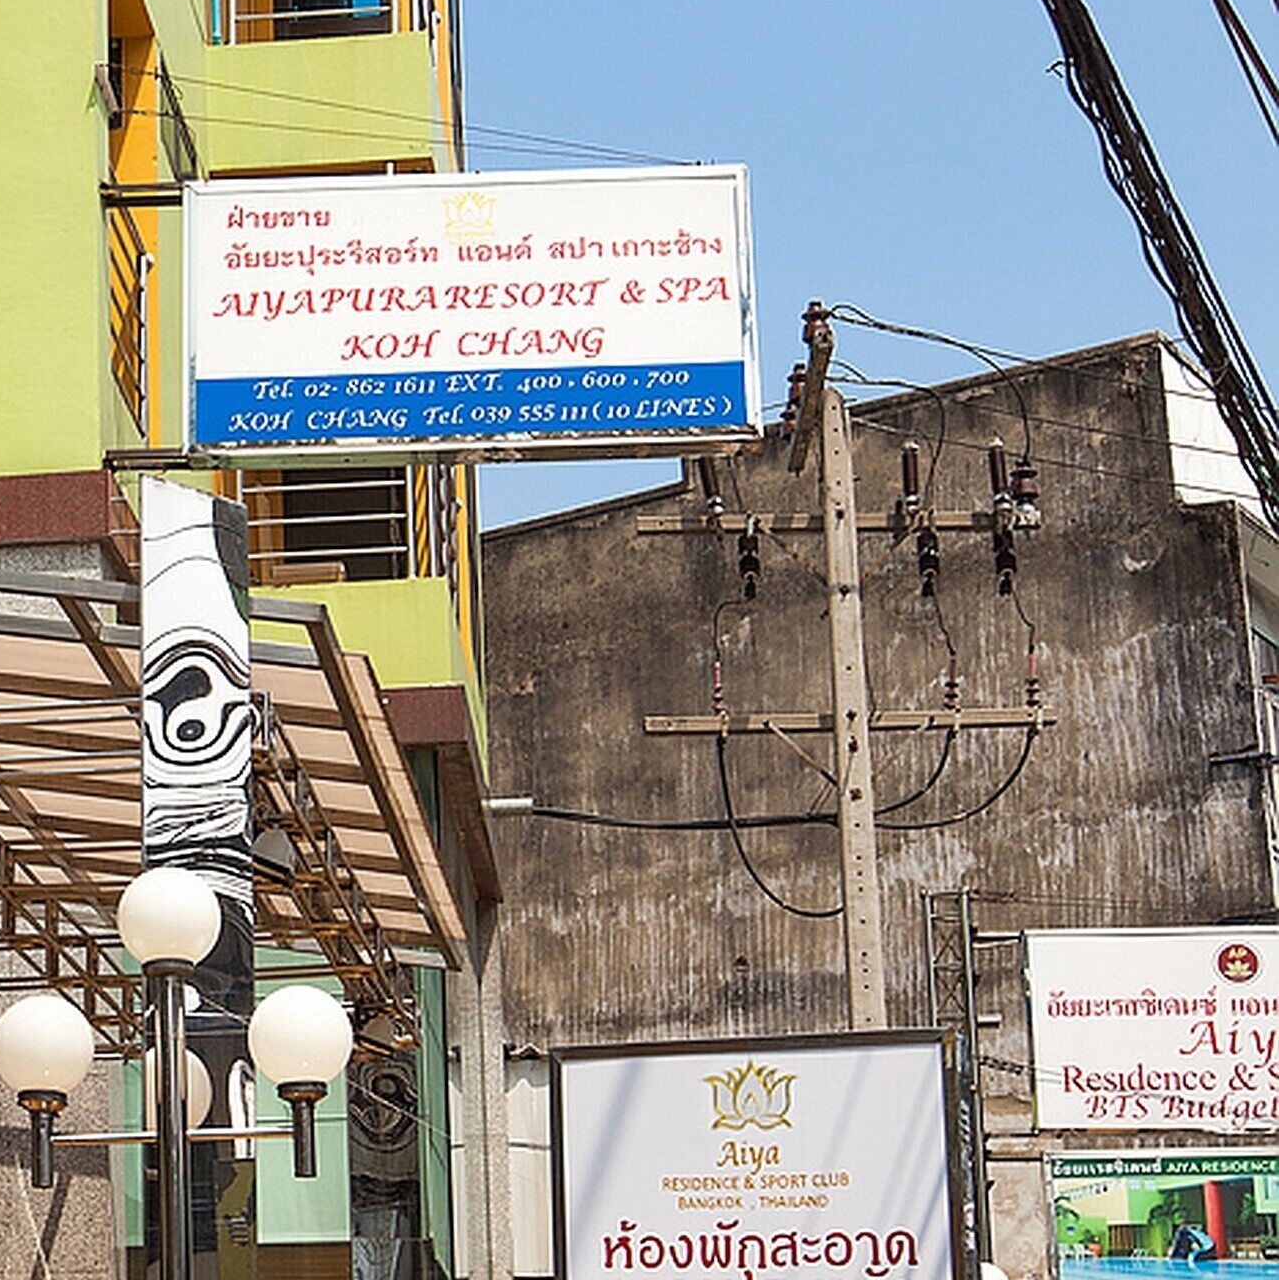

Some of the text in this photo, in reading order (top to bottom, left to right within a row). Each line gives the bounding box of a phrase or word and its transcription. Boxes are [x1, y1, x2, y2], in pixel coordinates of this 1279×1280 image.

[227, 205, 331, 229] ฝ่ายขาย
[459, 234, 532, 262] แอนด์
[548, 236, 603, 260] สปา
[612, 229, 722, 258] เกาะช้าง
[620, 279, 646, 305] &
[656, 276, 732, 304] SPA
[340, 326, 605, 361] KOH CHANG
[253, 379, 295, 400] Tel.
[228, 409, 295, 432] KOH
[307, 407, 409, 431] CHANG
[471, 406, 513, 424] 039
[1179, 1020, 1279, 1069] Aiy
[1062, 1062, 1218, 1093] Residence
[1228, 1062, 1259, 1092] &
[1085, 1094, 1150, 1120] BTS
[716, 1140, 781, 1176] Aiya
[1201, 1159, 1277, 1173] RESIDENCE
[661, 1171, 850, 1192] RESIDENCE & SPORT CLUB
[677, 1195, 744, 1211] BANGKOK
[759, 1193, 830, 1210] THAILAND
[603, 1220, 919, 1270] ห้องพักสะอาด
